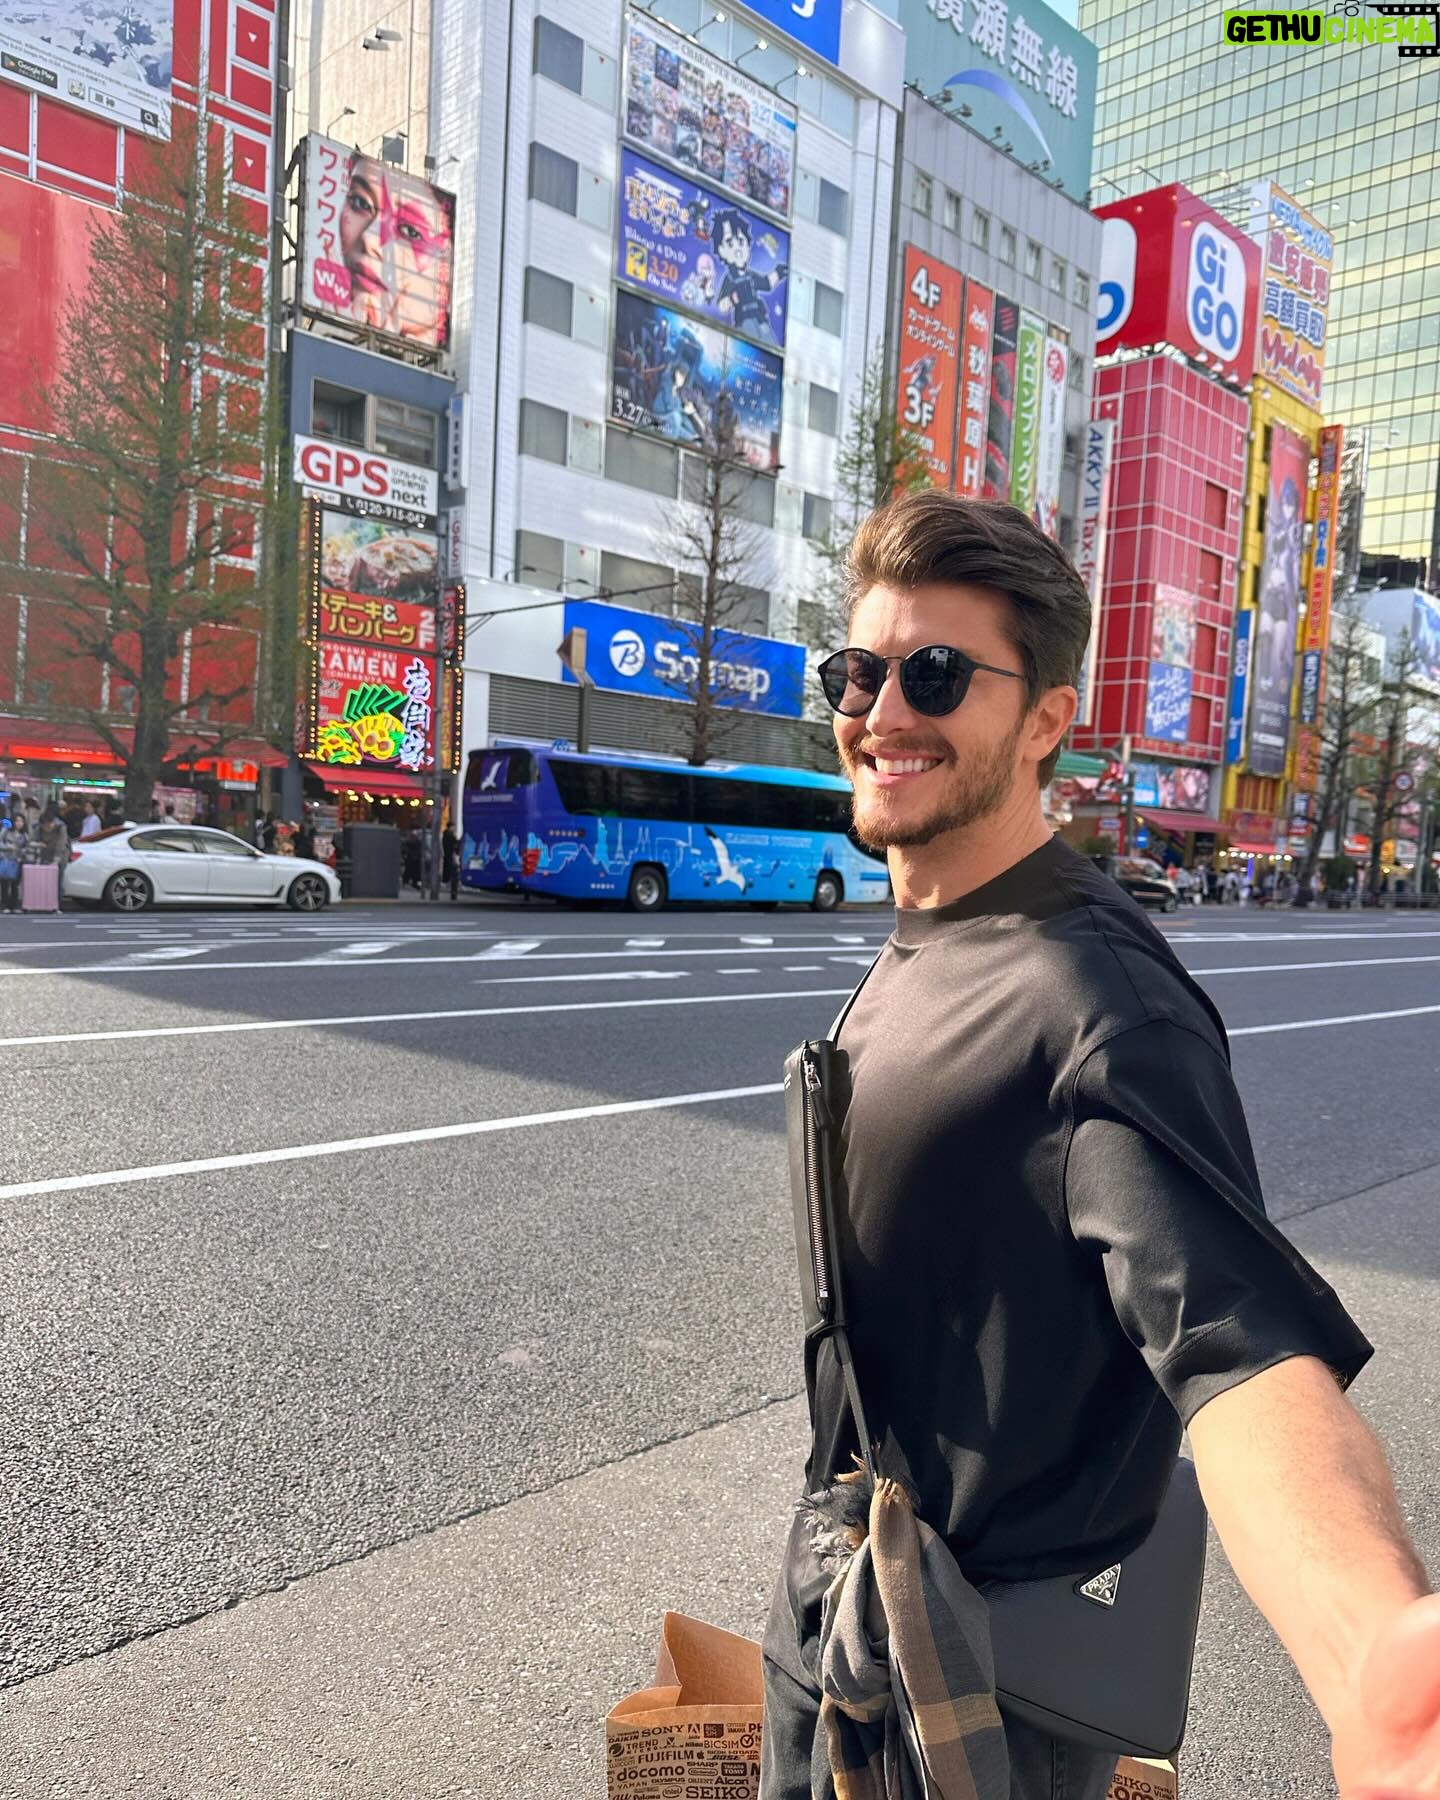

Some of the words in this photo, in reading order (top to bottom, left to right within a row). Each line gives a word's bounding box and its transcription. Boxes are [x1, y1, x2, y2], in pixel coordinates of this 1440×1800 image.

[911, 266, 941, 309] 4F
[613, 398, 644, 425] 3.27
[904, 386, 934, 429] 3F
[301, 444, 389, 497] GPS
[1085, 428, 1104, 491] AKKY
[391, 489, 427, 509] next
[329, 614, 416, 645] ハンバーグ
[418, 610, 435, 649] 2F
[653, 640, 770, 702] Somap
[1088, 1569, 1116, 1592] PRADA
[608, 1735, 639, 1744] DAIKIN
[641, 1725, 685, 1738] SONY
[626, 1739, 659, 1750] TREND
[638, 1750, 694, 1764] FUJIFILM
[616, 1766, 685, 1782] docomo
[714, 1776, 749, 1785] Alcon
[686, 1786, 750, 1800] SEIKO
